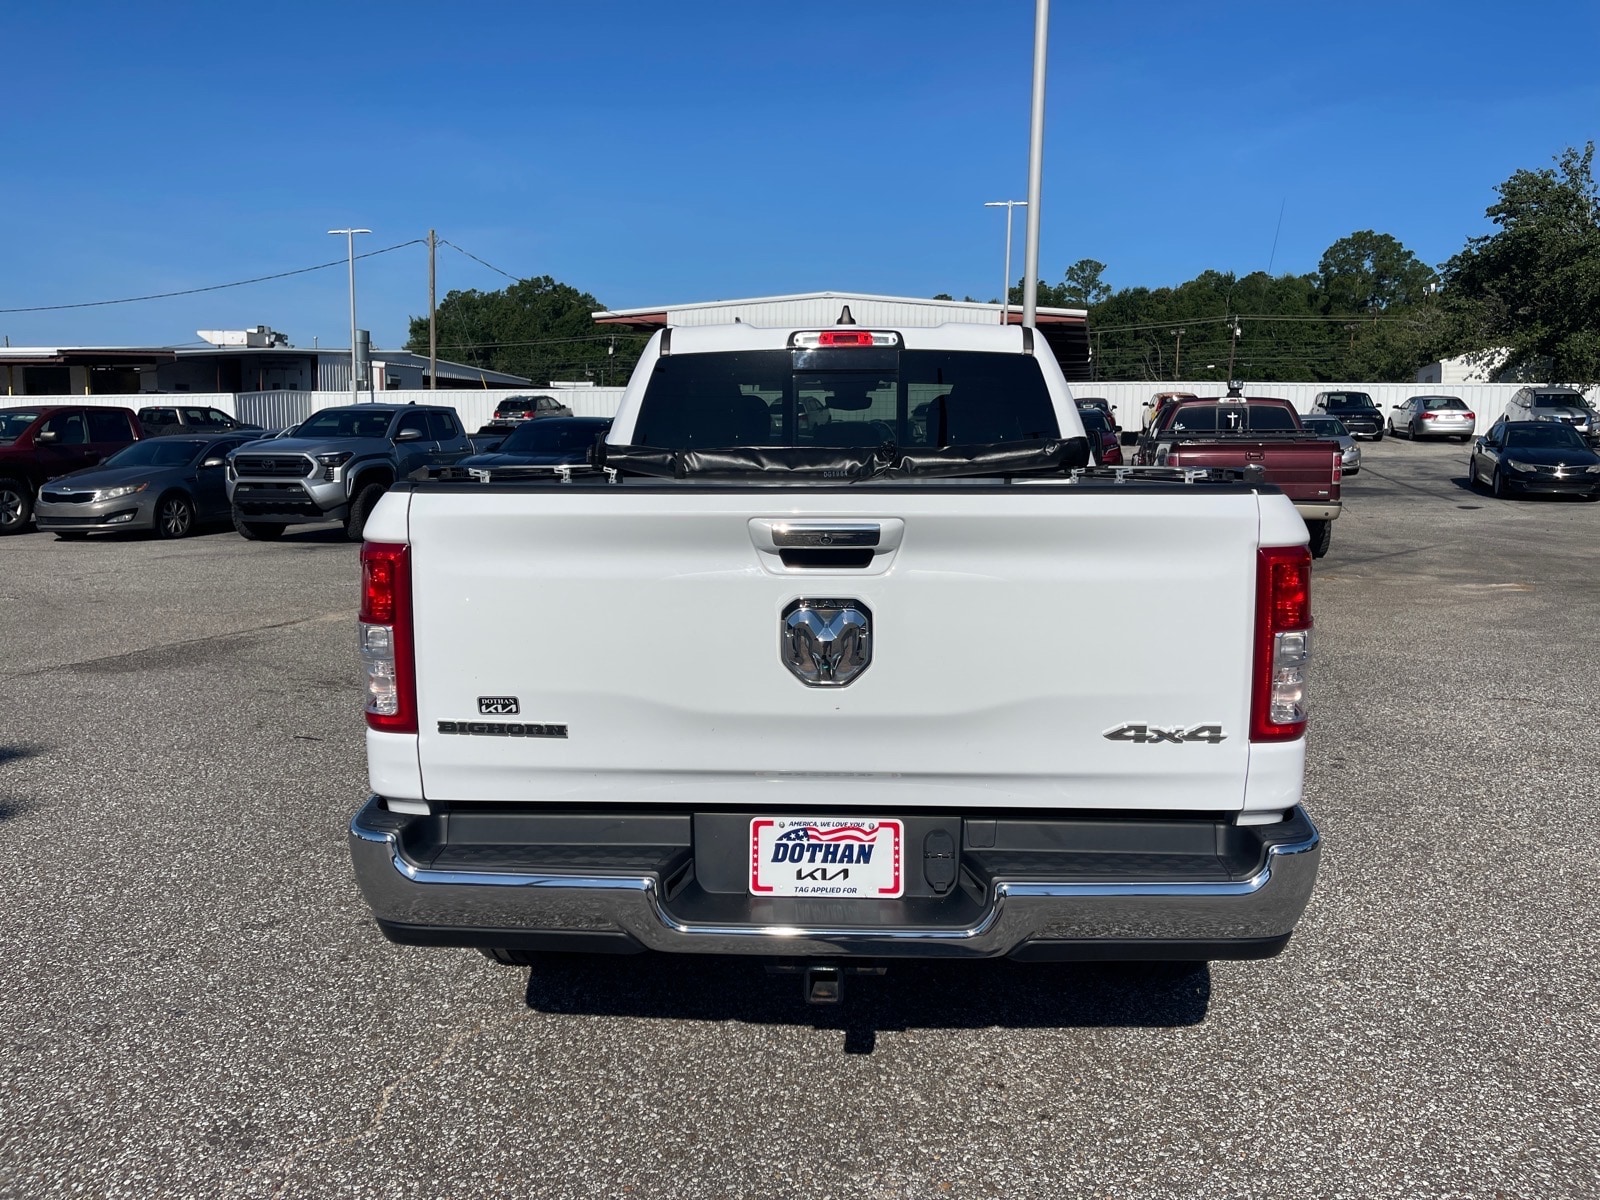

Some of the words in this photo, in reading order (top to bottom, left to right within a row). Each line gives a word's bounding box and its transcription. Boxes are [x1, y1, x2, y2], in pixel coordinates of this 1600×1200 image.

[481, 704, 517, 713] KIA
[437, 720, 568, 739] BIGHORN
[1102, 721, 1229, 744] 4x4
[788, 820, 819, 828] AMERICA,
[771, 842, 875, 865] DOTHAN
[796, 867, 849, 881] KIA
[810, 886, 841, 894] APPLIED
